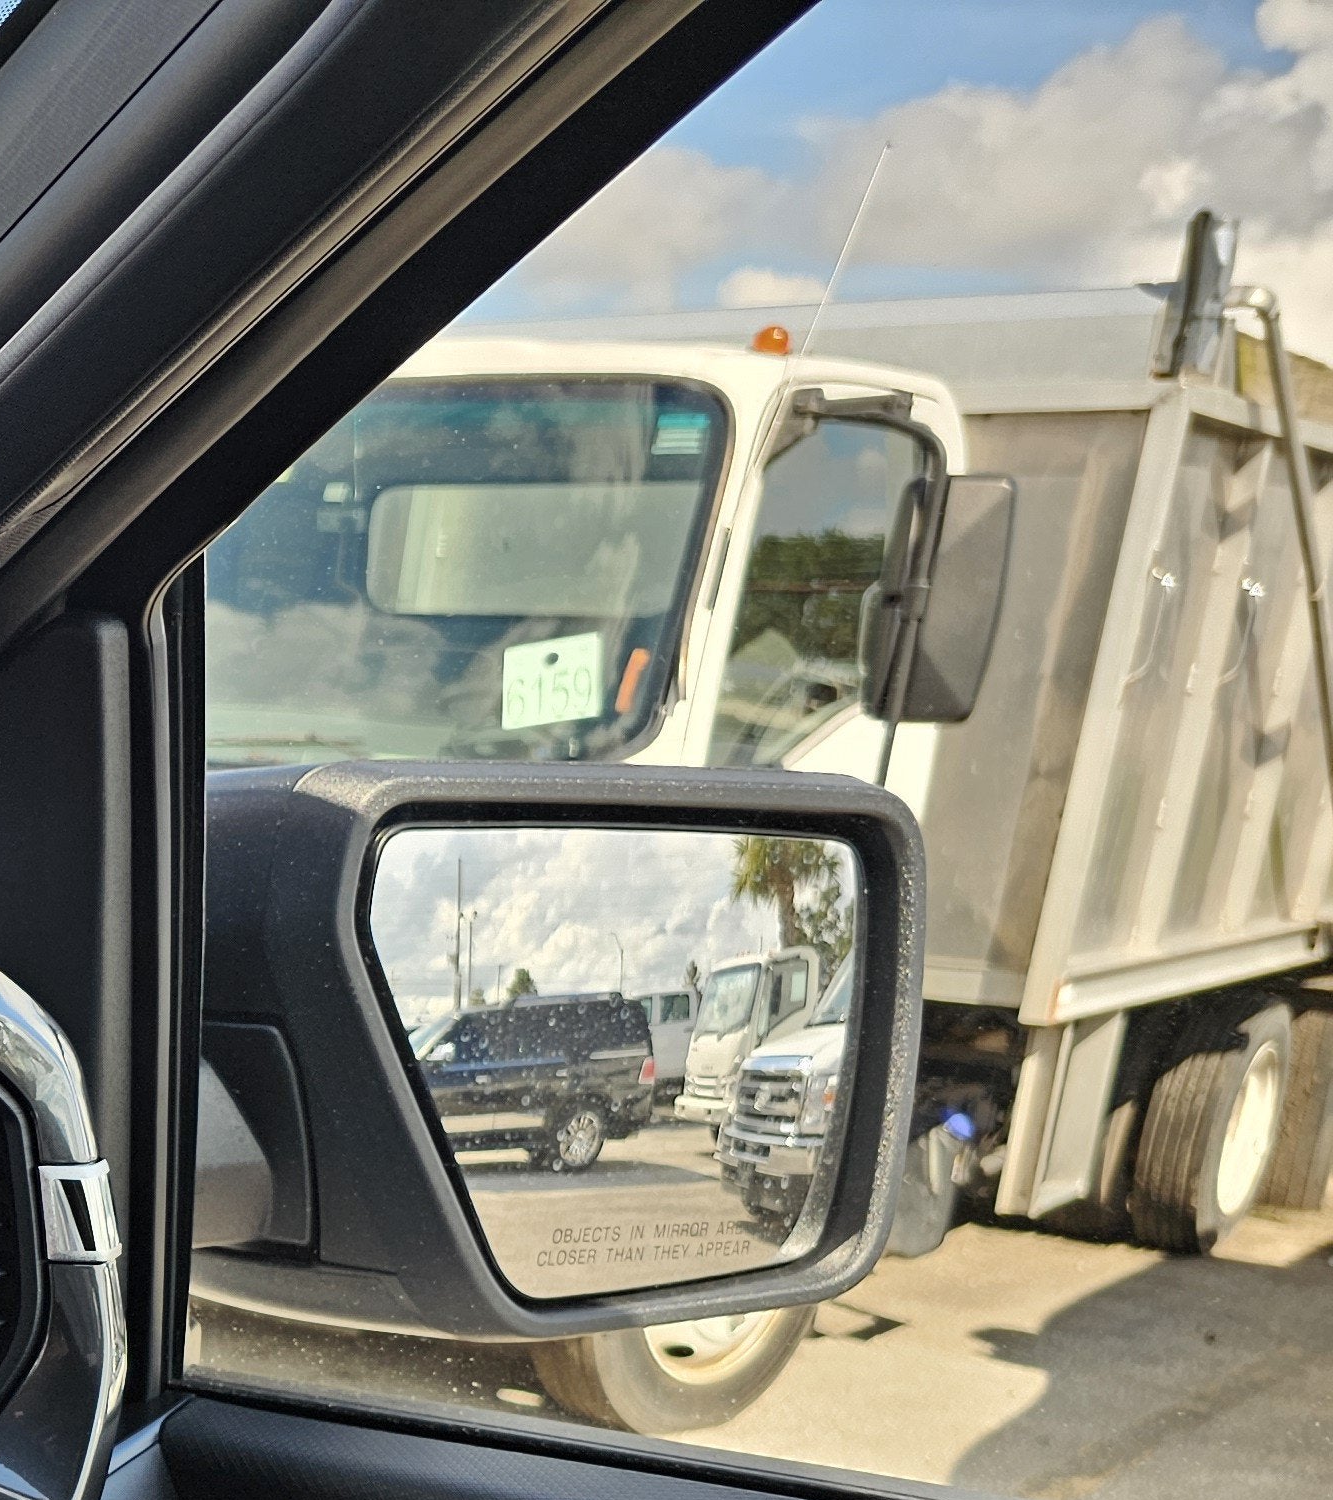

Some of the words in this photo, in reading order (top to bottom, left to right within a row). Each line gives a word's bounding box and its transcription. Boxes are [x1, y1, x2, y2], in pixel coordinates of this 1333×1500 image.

[507, 666, 592, 719] 6159
[552, 1226, 621, 1244] OBJECTS
[630, 1225, 644, 1241] IN
[653, 1222, 709, 1238] MIRROR
[537, 1249, 596, 1267] CLOSER
[606, 1247, 644, 1263] THAN
[654, 1244, 690, 1261] THEY
[696, 1240, 751, 1257] APPEAR
